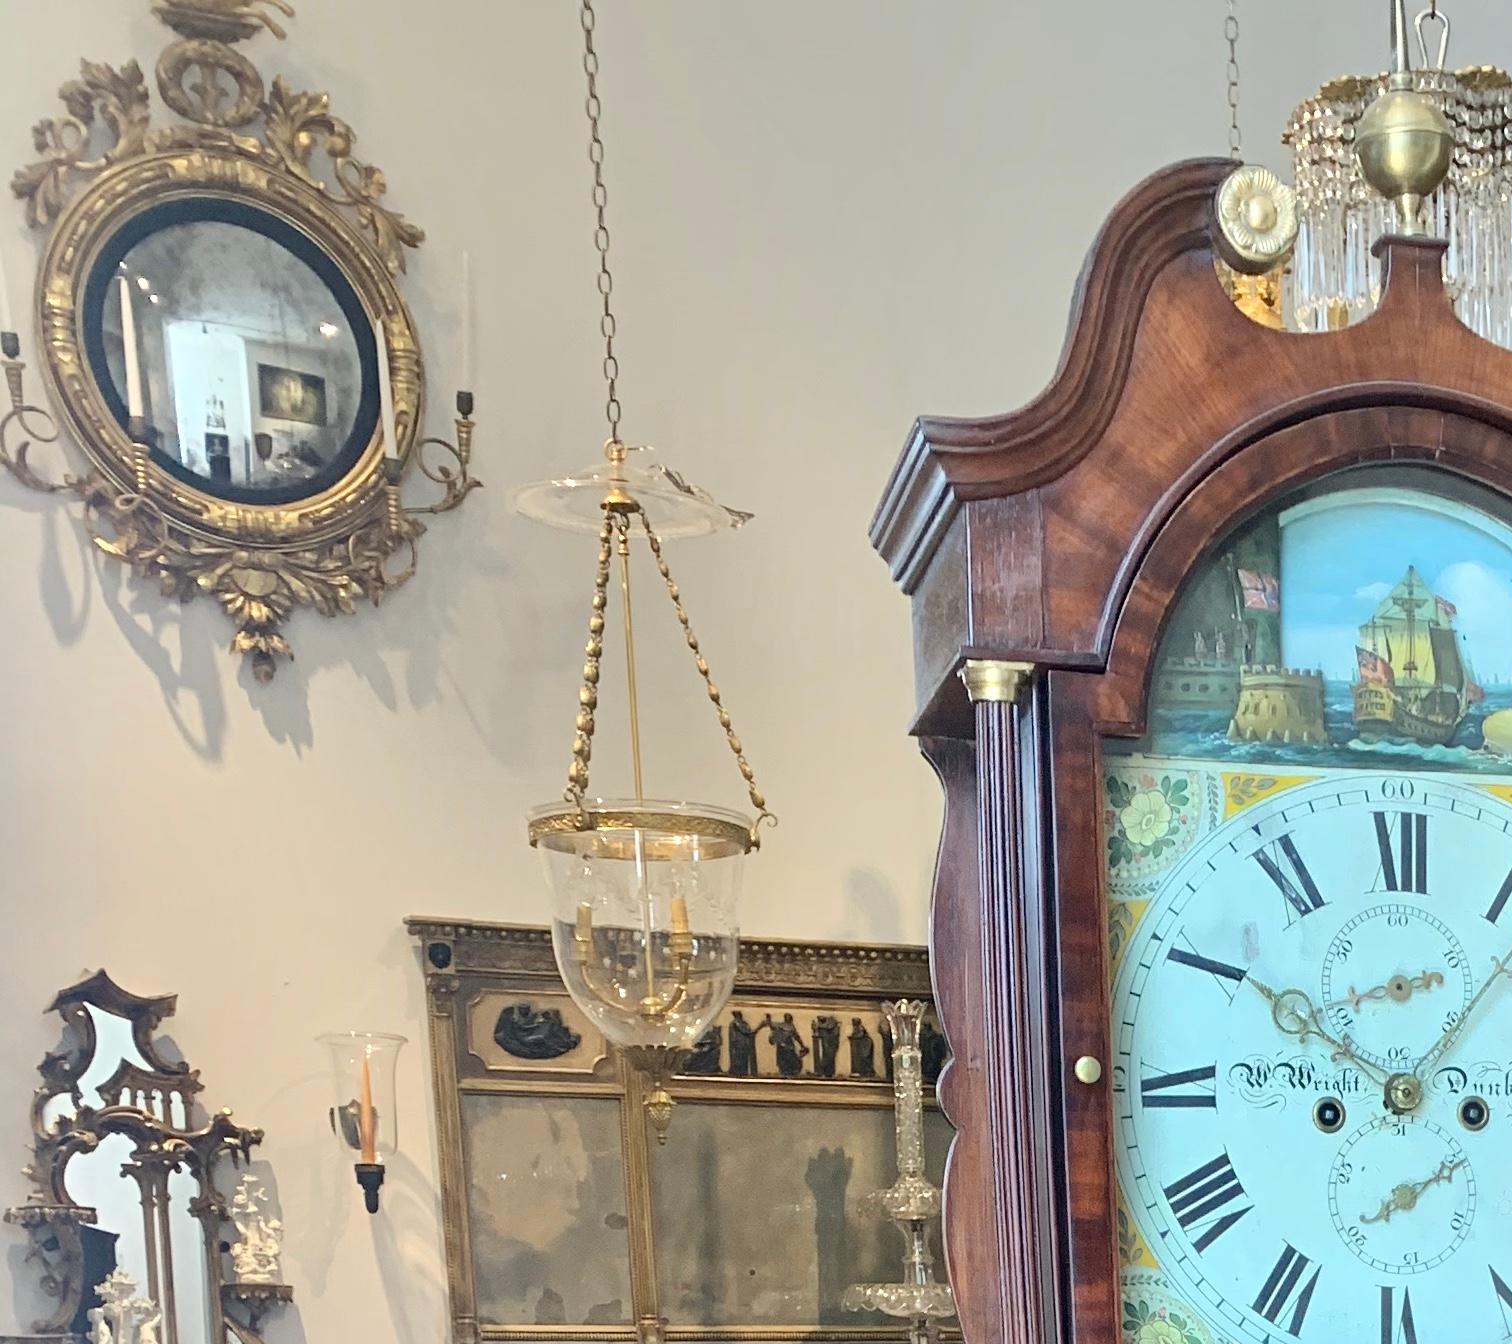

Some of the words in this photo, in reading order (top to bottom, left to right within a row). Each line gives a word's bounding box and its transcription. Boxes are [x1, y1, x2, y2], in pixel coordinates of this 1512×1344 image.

[1381, 779, 1415, 799] 60
[1365, 811, 1434, 895] XII
[1245, 830, 1334, 931] XI
[1387, 914, 1409, 927] 60
[1337, 940, 1353, 964] 50
[1442, 948, 1460, 969] 10
[1163, 926, 1250, 1006] X
[1387, 1047, 1411, 1060] 30
[1141, 1060, 1218, 1115] IX
[1338, 1163, 1353, 1184] 25
[1161, 1144, 1255, 1258] VIII
[1450, 1212, 1465, 1231] 10
[1348, 1226, 1368, 1246] 20
[1403, 1252, 1419, 1264] 15
[1246, 1239, 1322, 1340] VII
